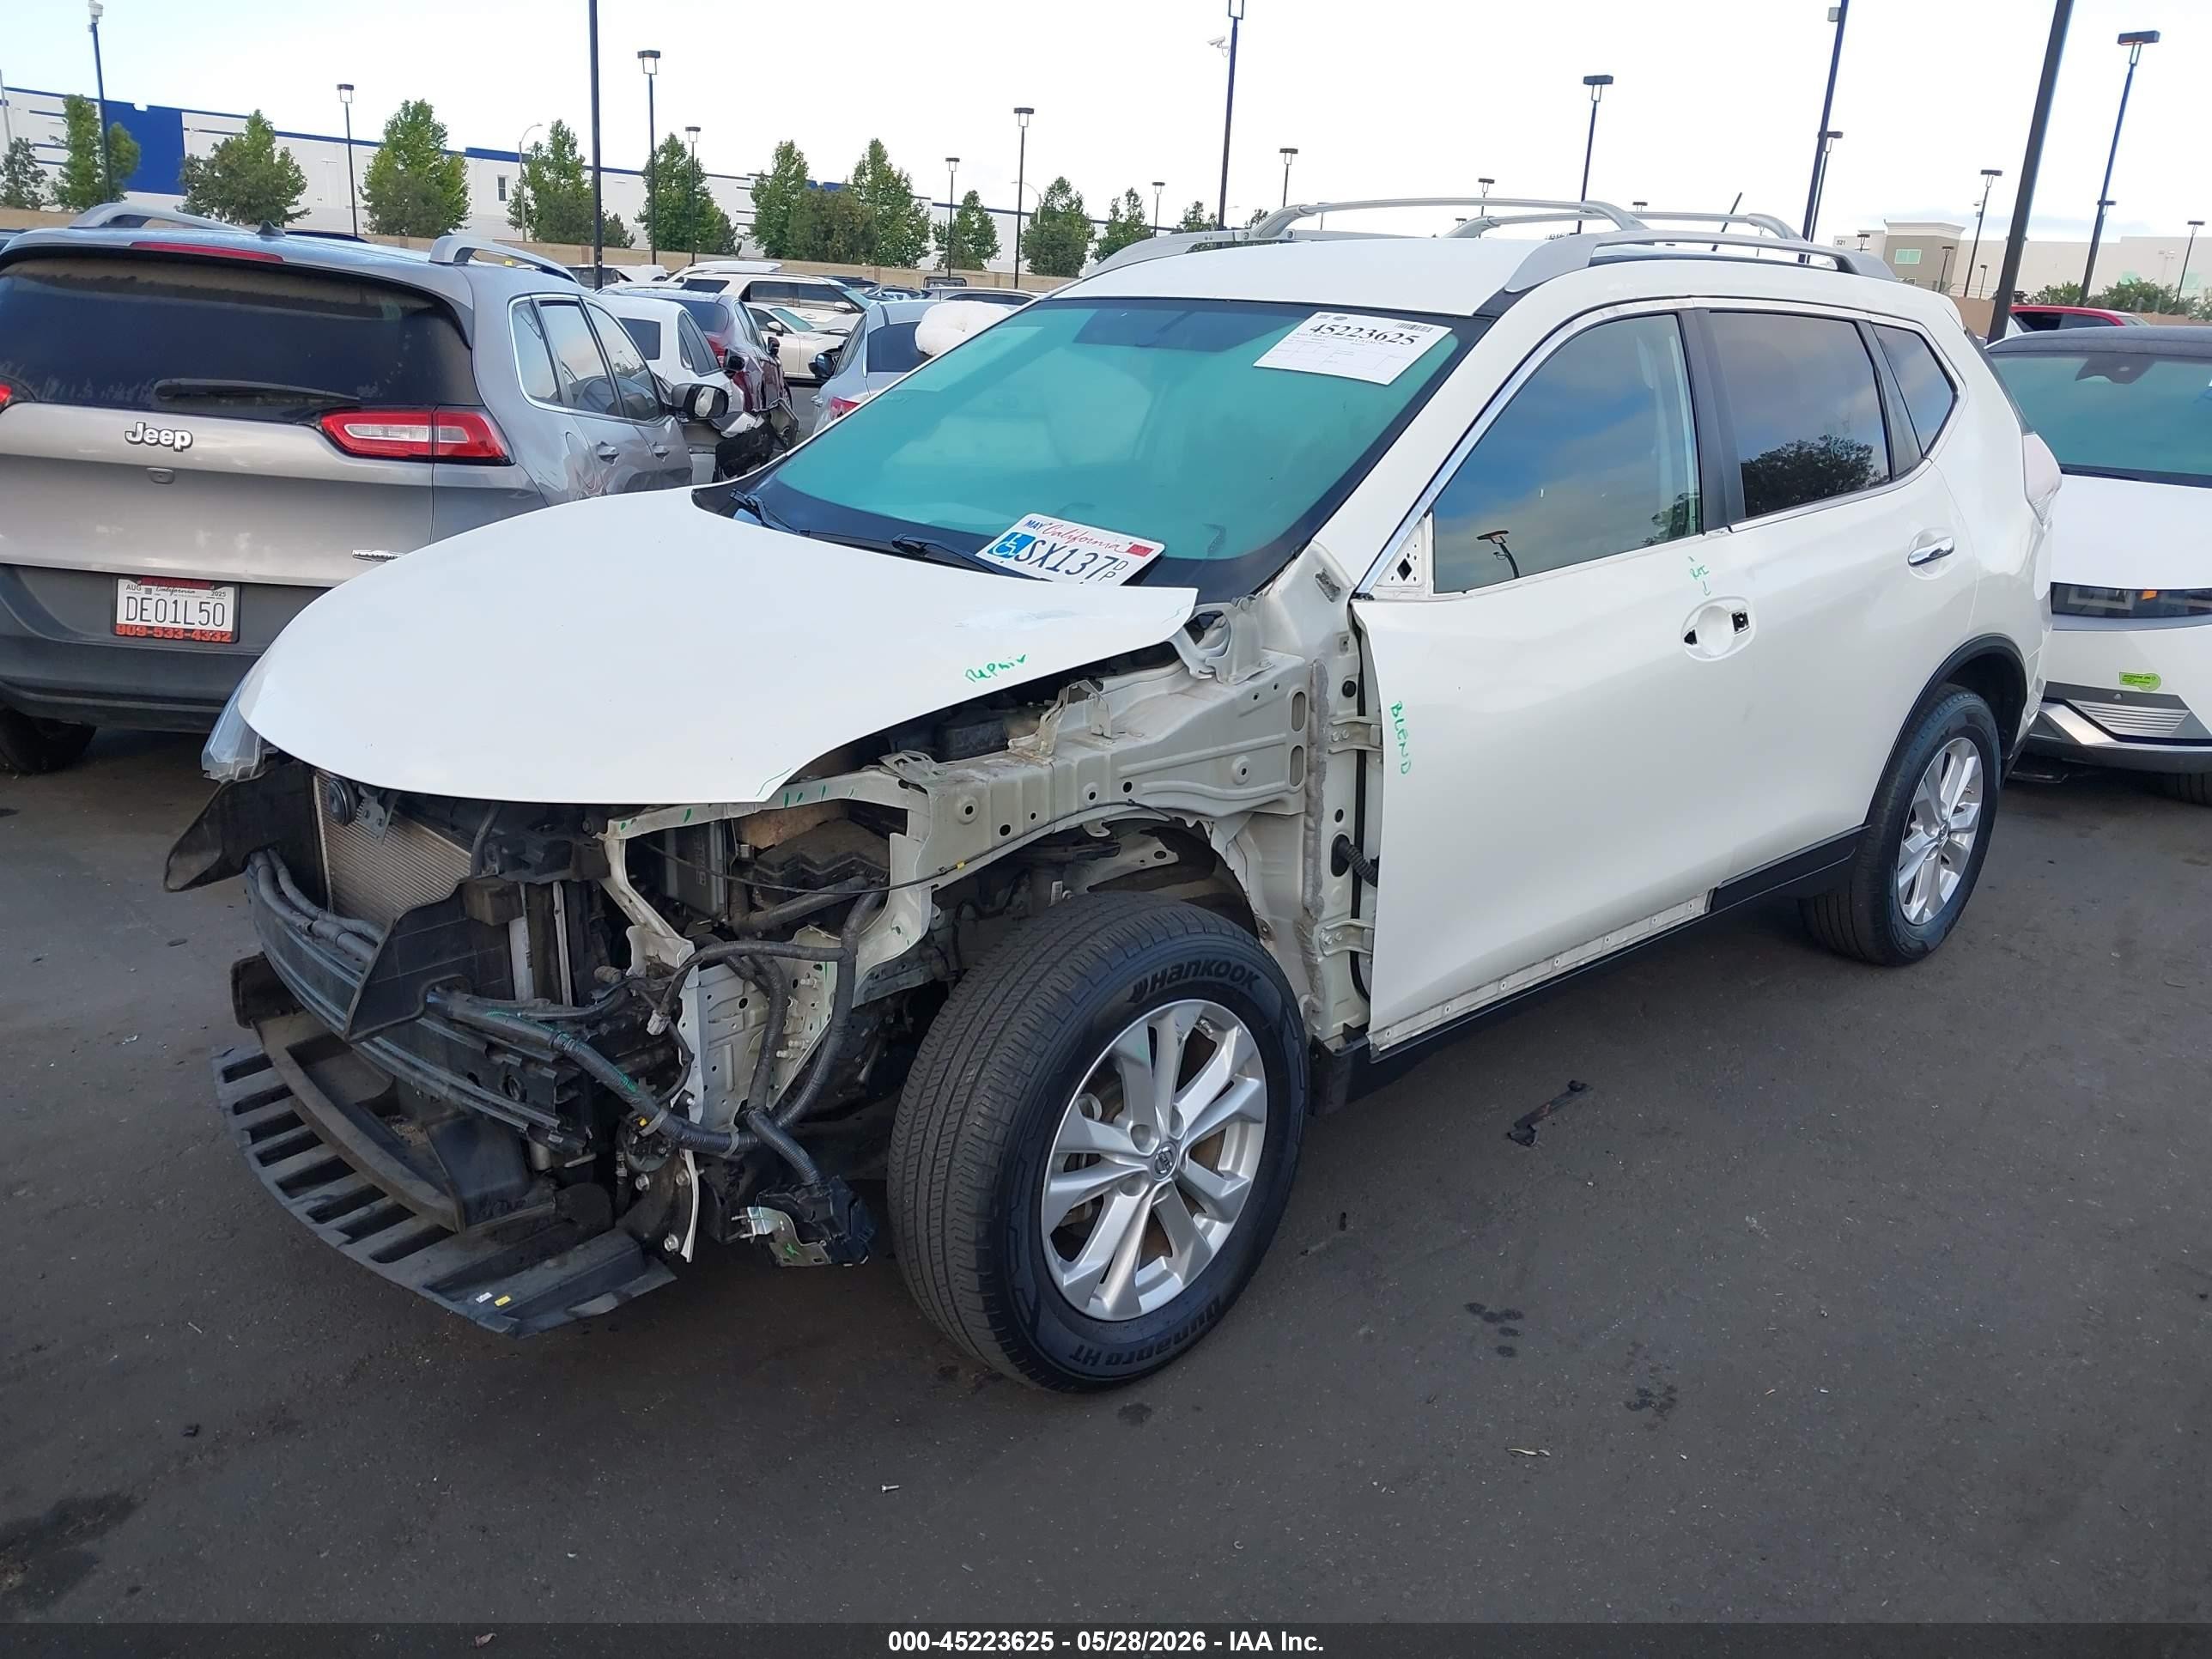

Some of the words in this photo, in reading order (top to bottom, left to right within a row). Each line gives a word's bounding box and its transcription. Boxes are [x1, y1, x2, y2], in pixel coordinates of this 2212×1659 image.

[1310, 323, 1421, 345] 45223625
[125, 422, 193, 453] Jeep
[1024, 520, 1045, 532] MAY
[1041, 521, 1129, 554] California
[1013, 539, 1120, 580] SX137
[125, 596, 225, 628] DE01L50
[115, 624, 233, 642] 909-533-4332
